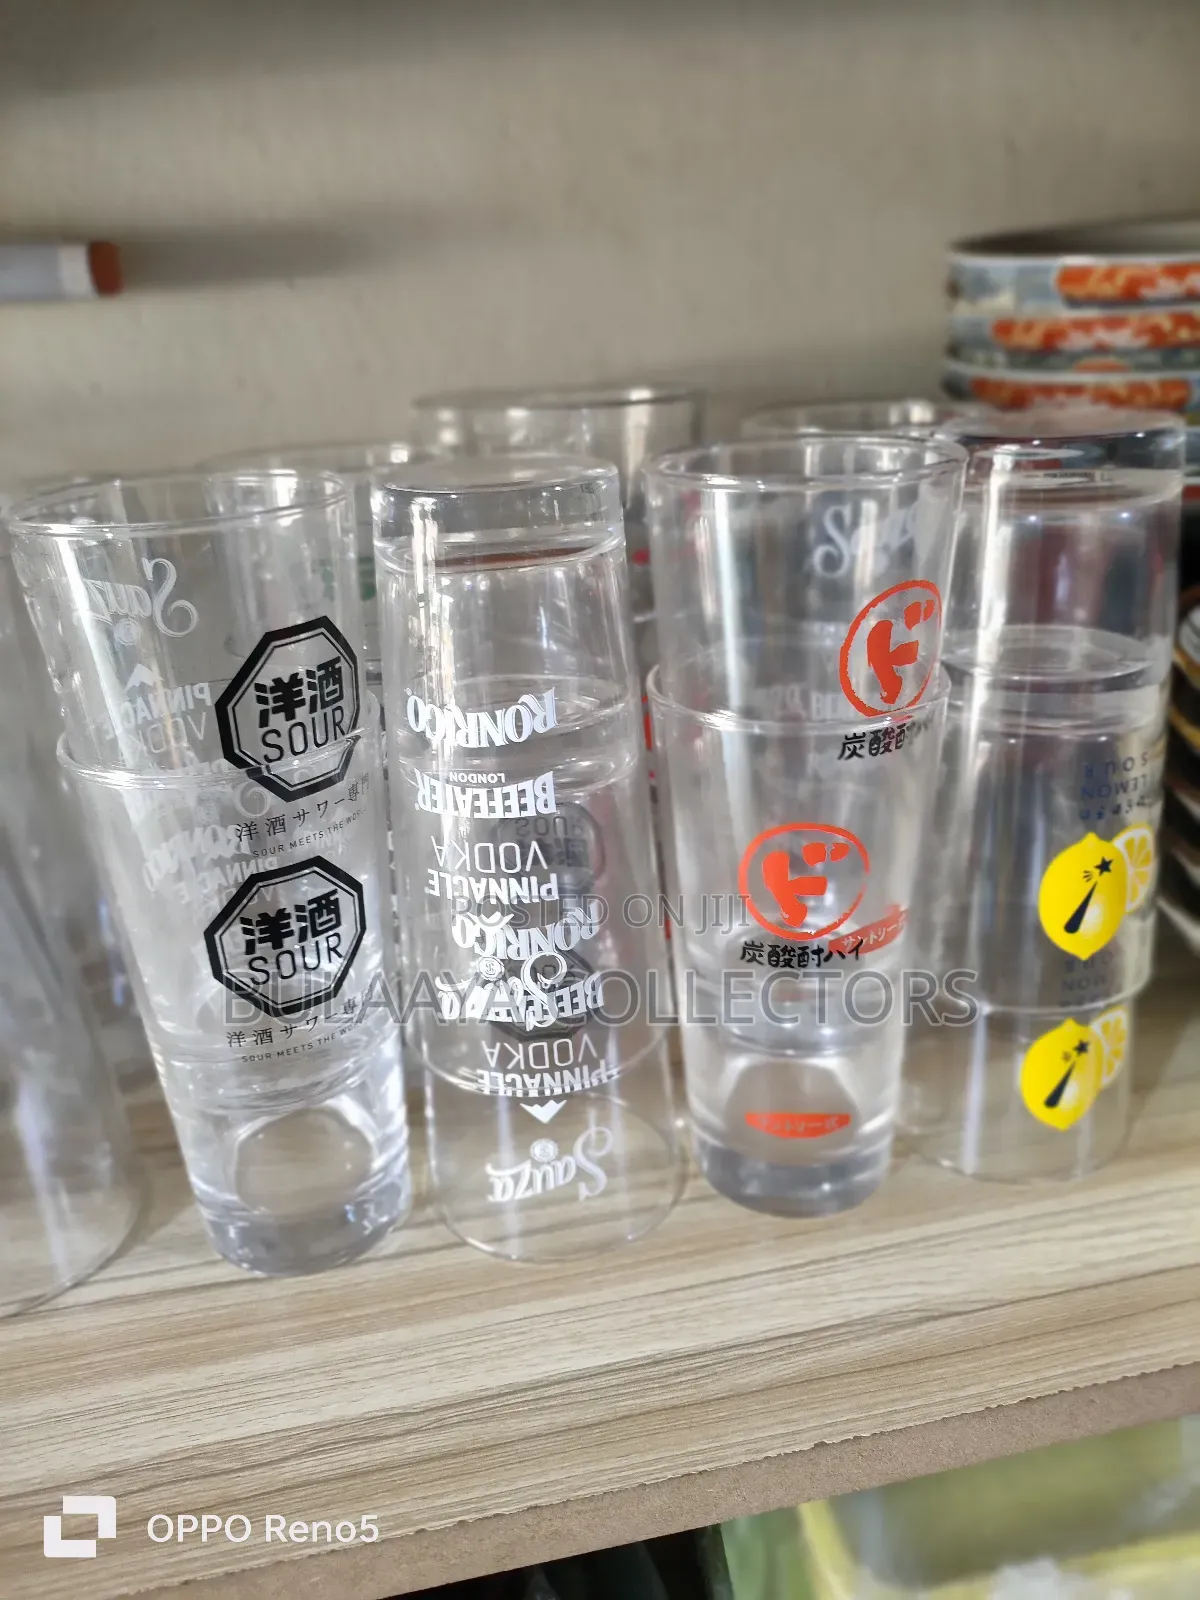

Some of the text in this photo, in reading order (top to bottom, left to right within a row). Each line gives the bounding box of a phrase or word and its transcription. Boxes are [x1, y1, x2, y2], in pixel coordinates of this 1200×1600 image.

[254, 655, 346, 729] 洋酒
[260, 705, 349, 765] SOUR
[405, 686, 560, 748] RONRICO
[413, 767, 558, 819] BEEFEATER
[449, 772, 506, 784] LONDON
[252, 844, 286, 858] SOUR
[289, 830, 325, 850] MEETS
[327, 820, 344, 835] THE
[430, 835, 548, 874] VODKA
[427, 868, 560, 905] PINNACLE
[761, 841, 850, 929] ド
[239, 888, 343, 956] 洋酒
[247, 931, 344, 986] SOUR
[739, 938, 864, 969] 炭酸酎ハイ
[241, 1052, 272, 1063] SOUR
[276, 1042, 314, 1058] MEETS
[316, 1032, 337, 1046] THE
[481, 1033, 598, 1070] VODKA
[476, 1059, 607, 1098] PINNACLE
[484, 1126, 614, 1202] Sauza
